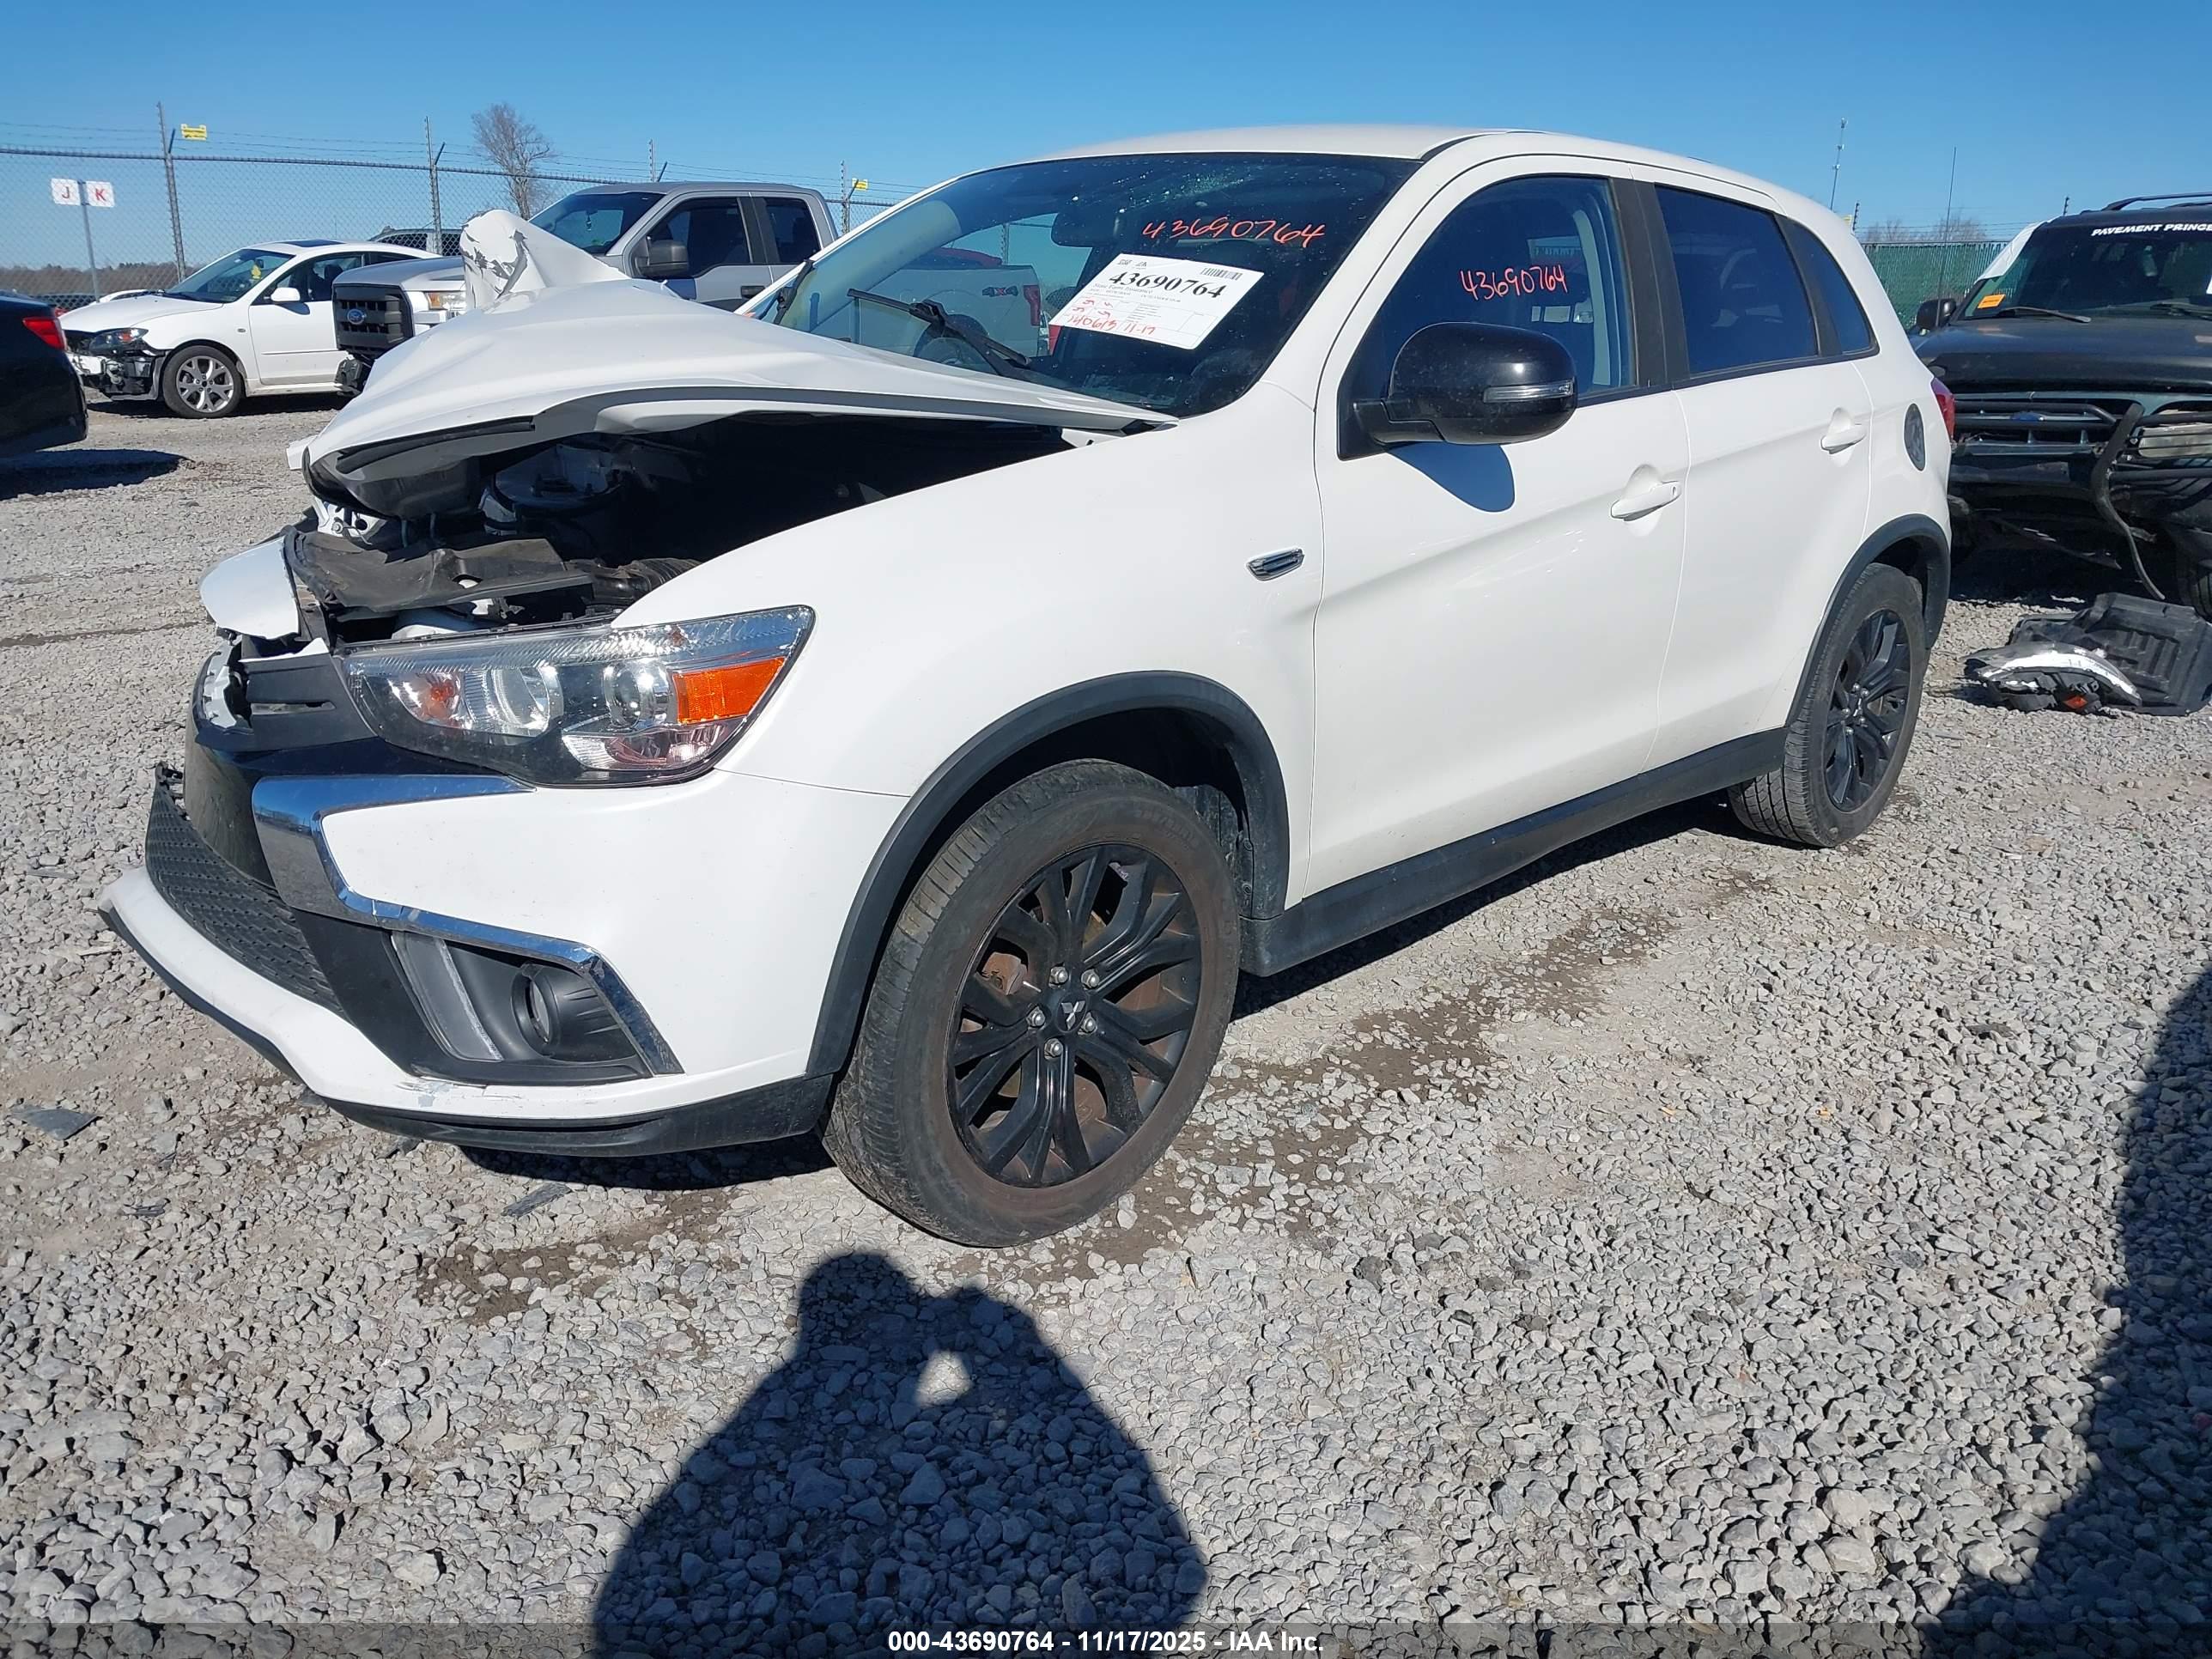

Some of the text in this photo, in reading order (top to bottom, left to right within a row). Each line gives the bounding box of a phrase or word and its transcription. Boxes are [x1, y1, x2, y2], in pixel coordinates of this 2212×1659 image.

[61, 186, 70, 199] J
[94, 188, 106, 201] K
[1142, 216, 1326, 248] 43690764
[2091, 224, 2163, 236] PAVEMENT
[1109, 271, 1227, 298] 43690764
[1460, 264, 1568, 301] 43690764
